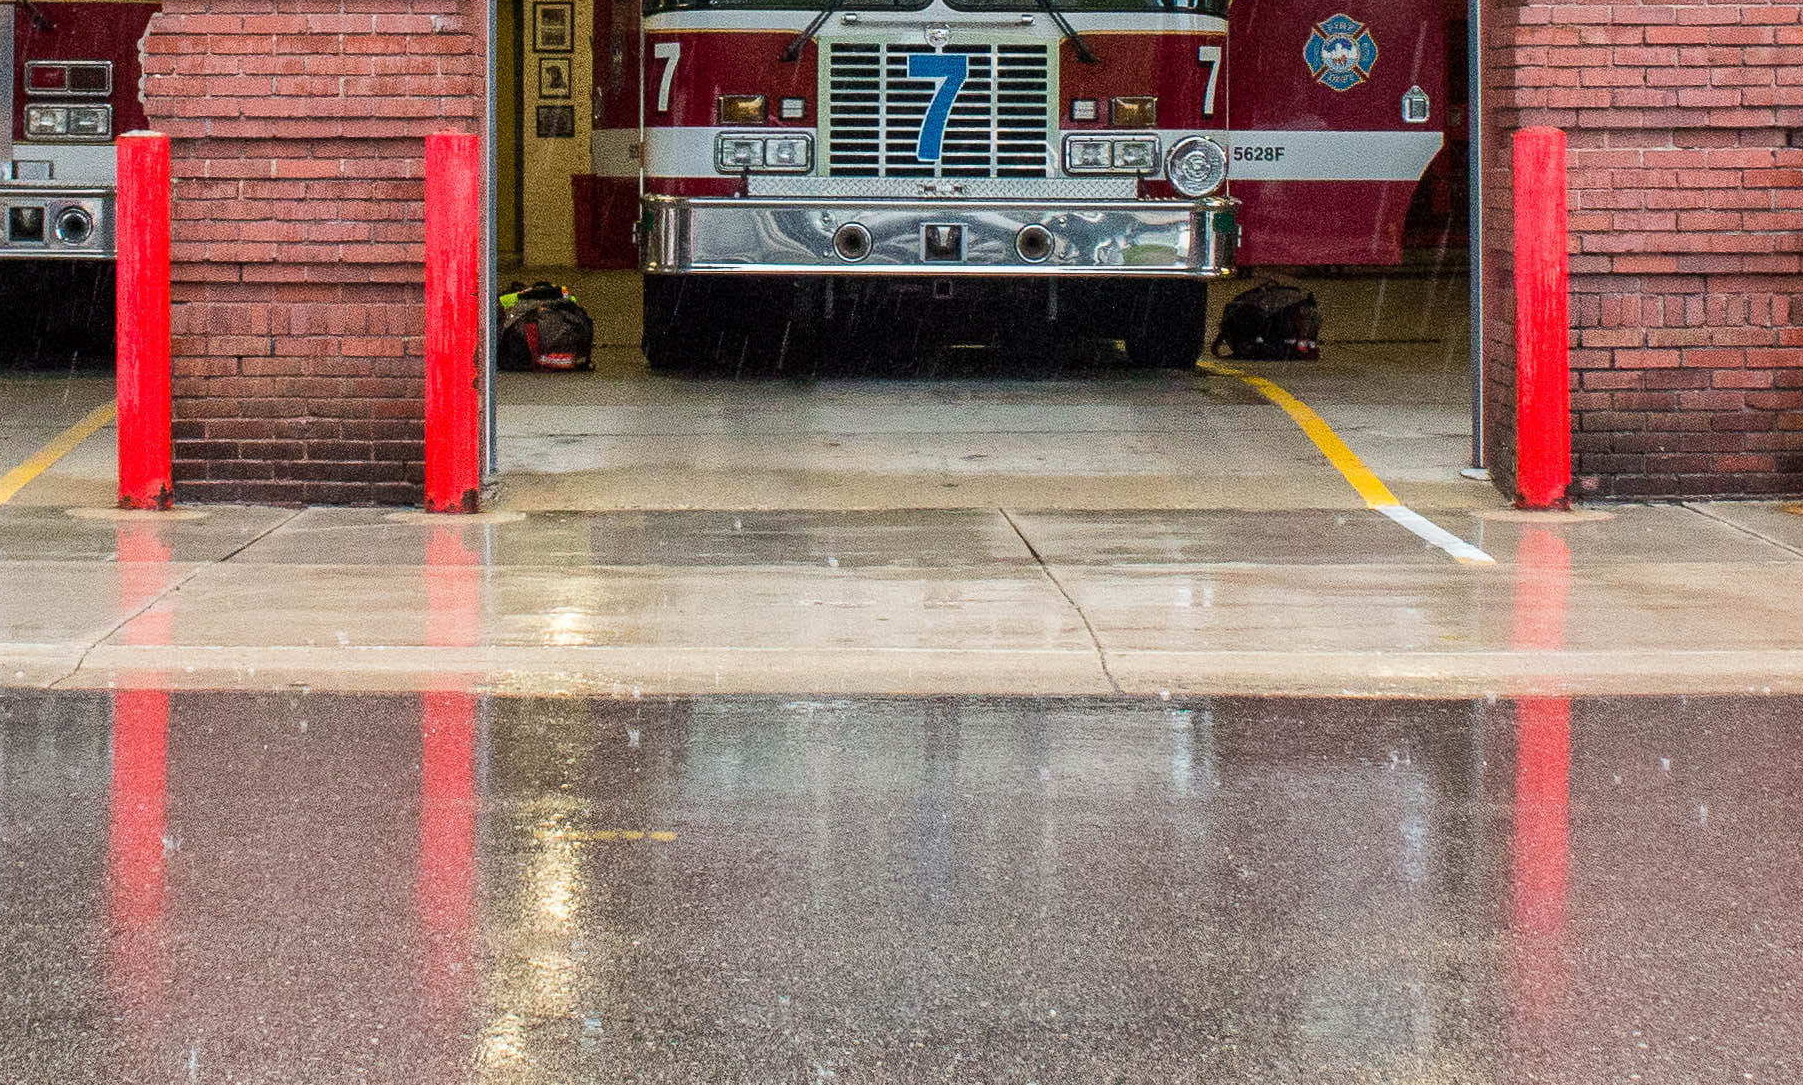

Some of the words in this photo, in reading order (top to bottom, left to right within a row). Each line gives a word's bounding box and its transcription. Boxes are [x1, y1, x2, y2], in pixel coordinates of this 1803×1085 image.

[653, 41, 682, 113] 7
[906, 53, 970, 163] 7
[1198, 45, 1222, 115] 7
[1232, 145, 1286, 162] 5628F
